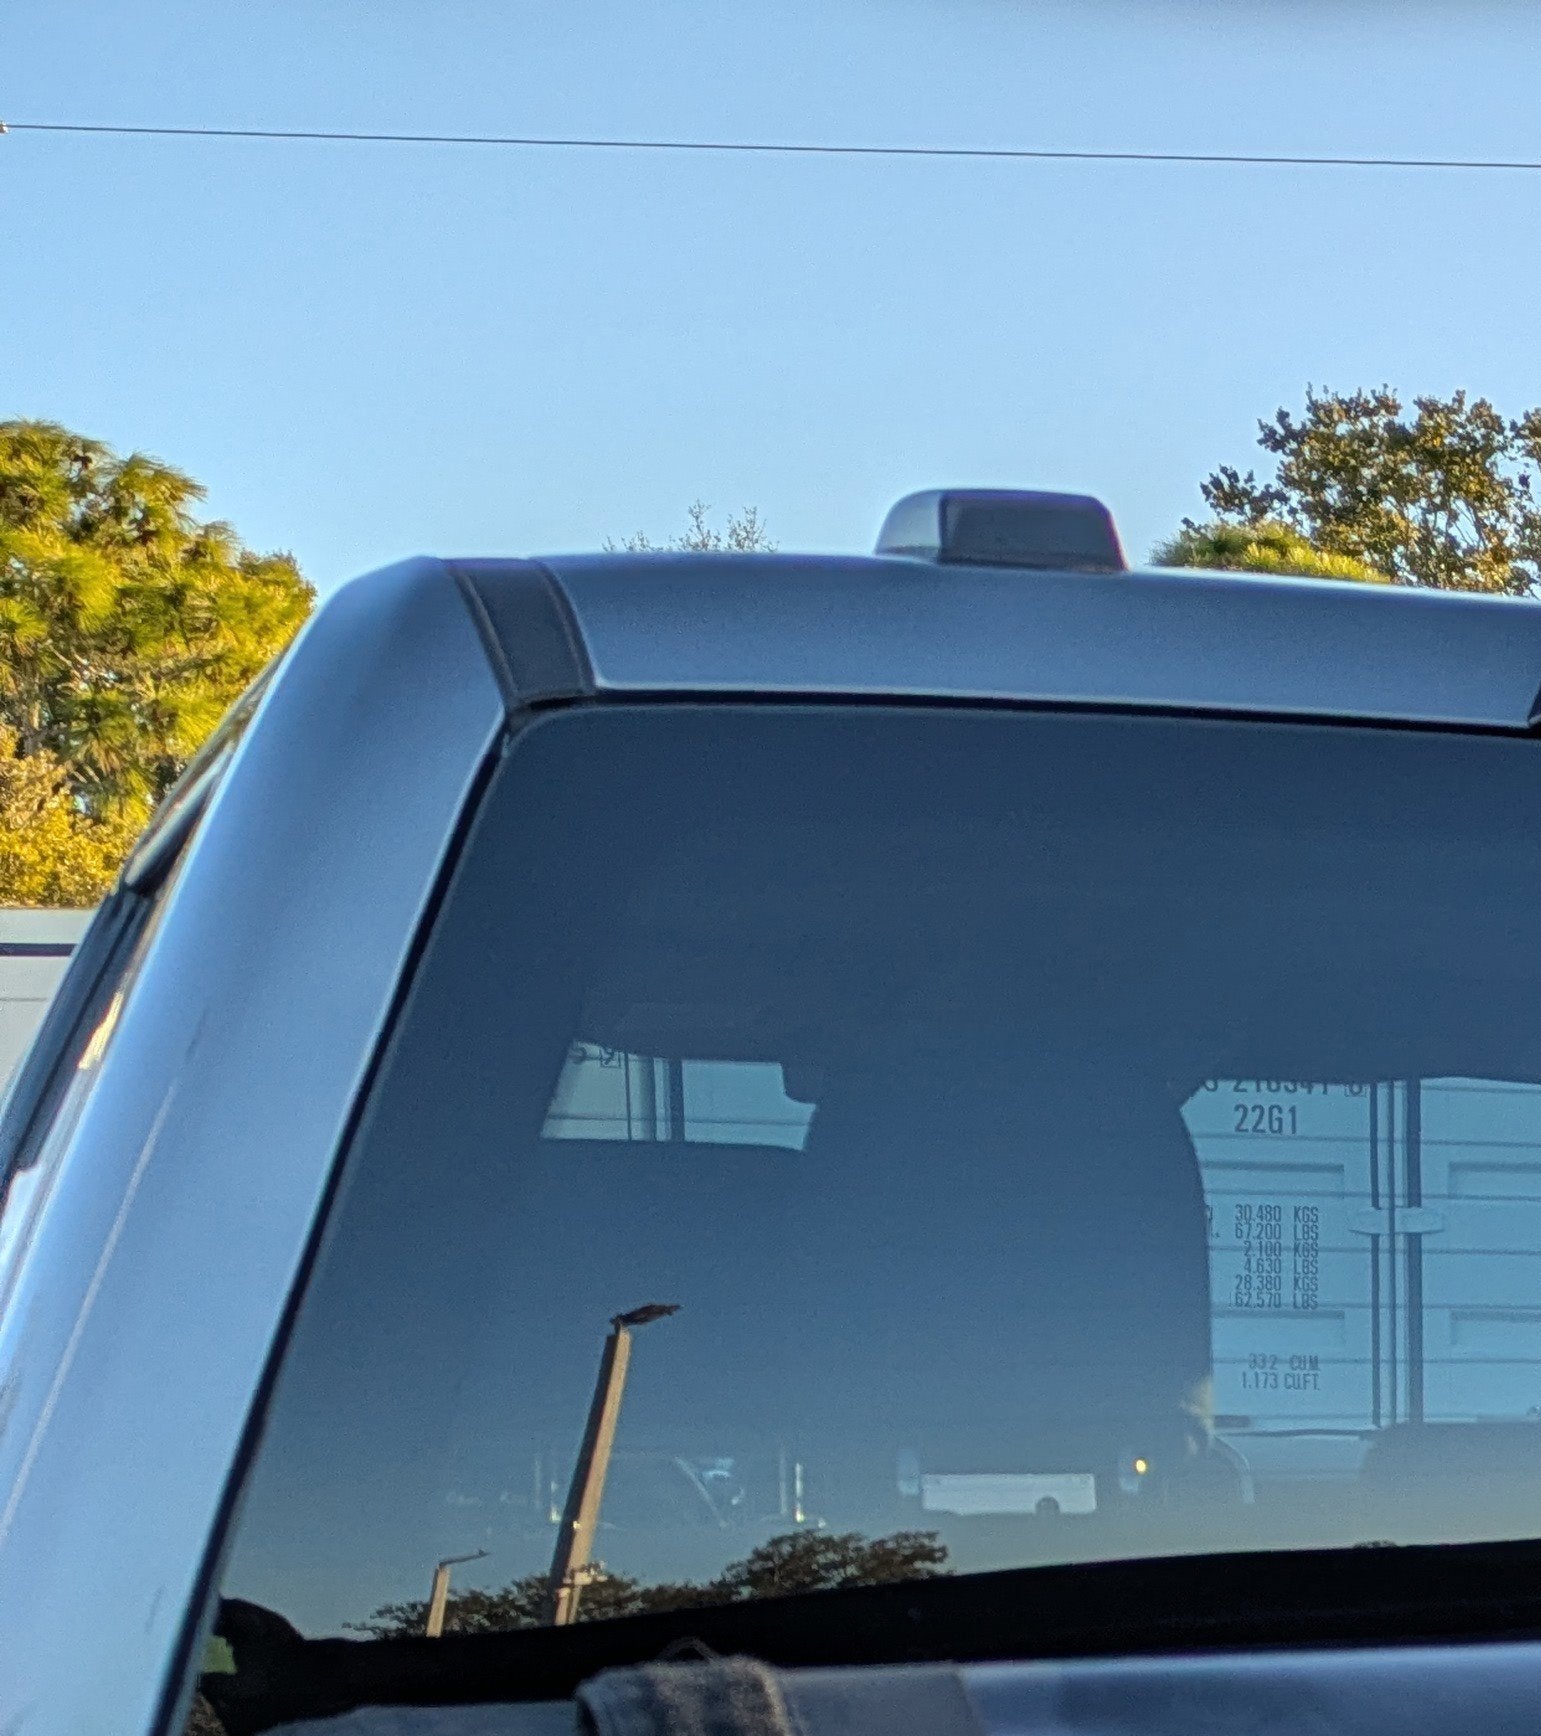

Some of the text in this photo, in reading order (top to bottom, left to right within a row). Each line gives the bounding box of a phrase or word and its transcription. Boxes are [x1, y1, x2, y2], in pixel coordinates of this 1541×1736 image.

[1234, 1104, 1297, 1134] 22G1
[1293, 1205, 1319, 1224] KGS
[1293, 1223, 1319, 1241] LBS
[1293, 1241, 1319, 1259] KGS
[1293, 1258, 1319, 1276] LBS
[1293, 1275, 1319, 1293] KGS
[1293, 1291, 1319, 1310] LBS
